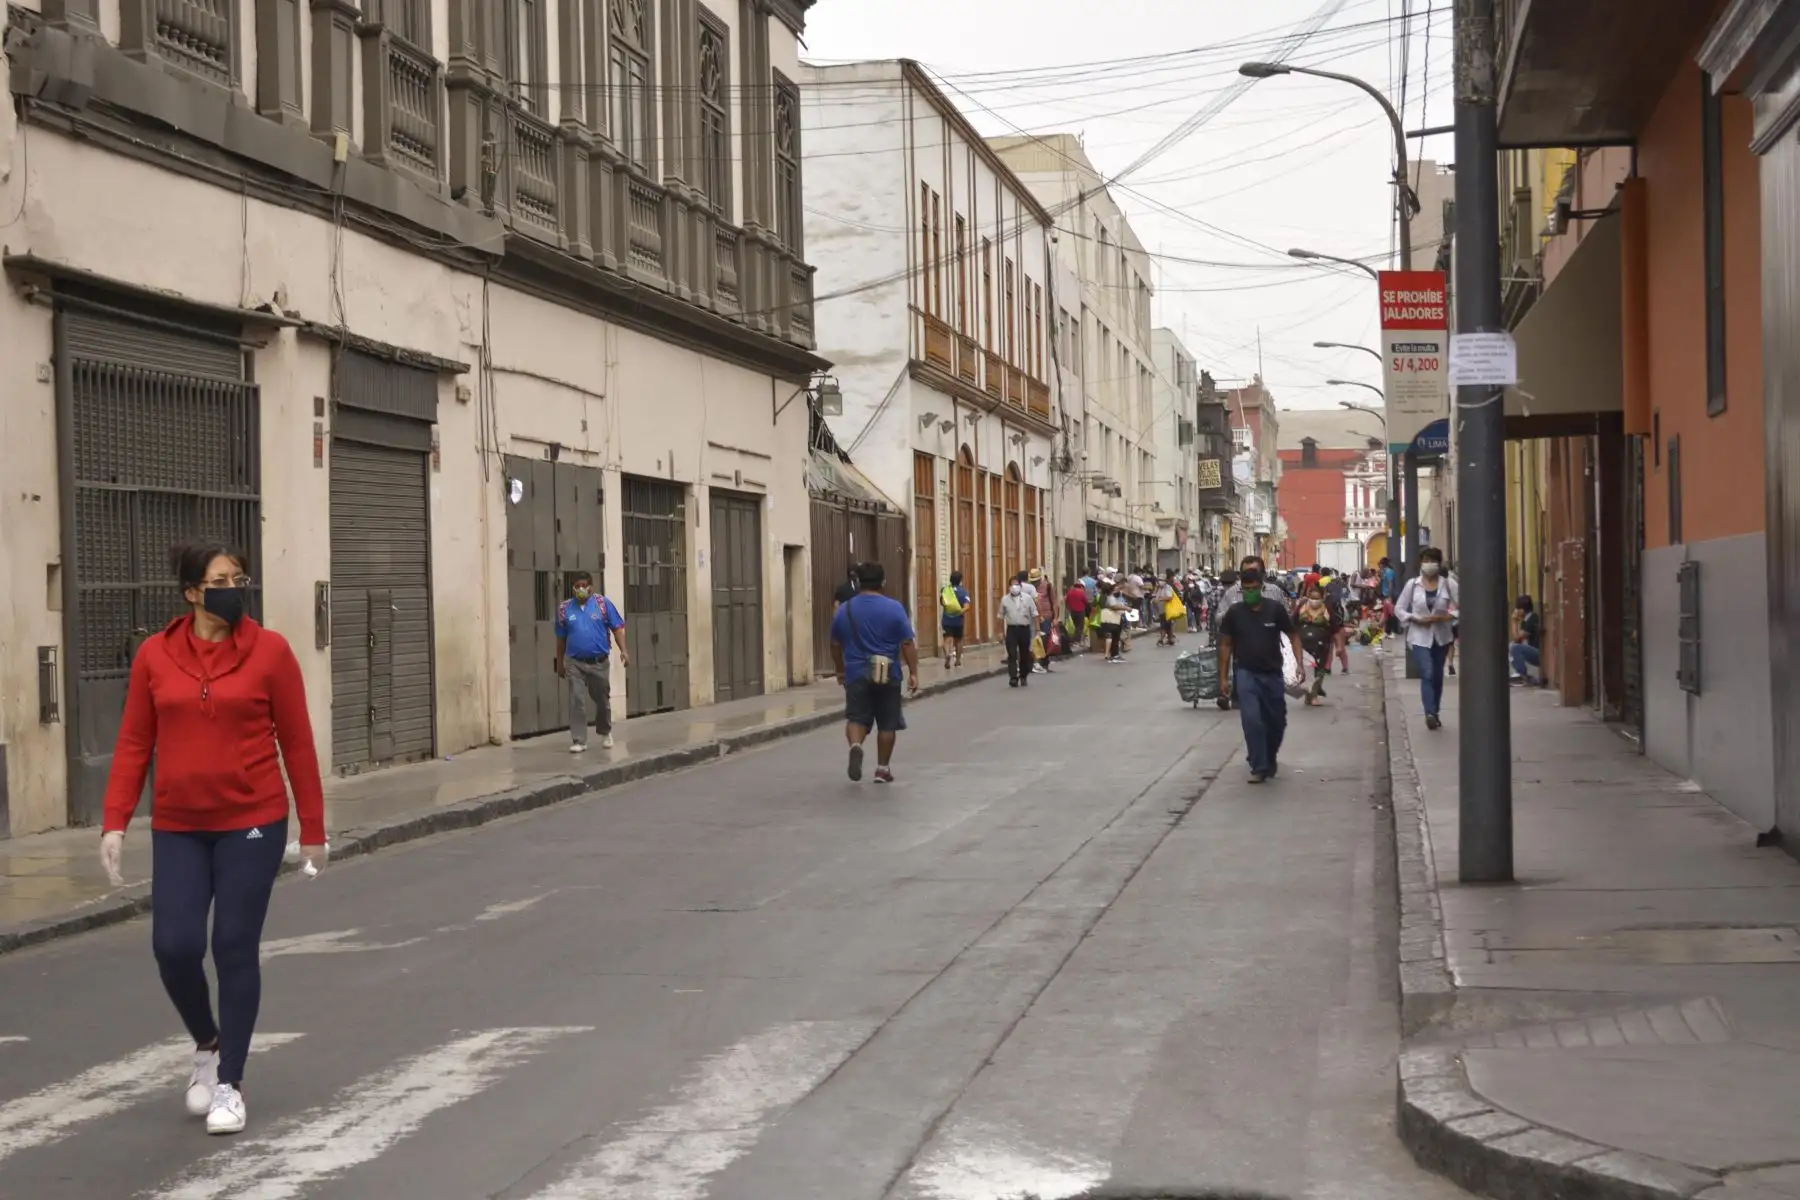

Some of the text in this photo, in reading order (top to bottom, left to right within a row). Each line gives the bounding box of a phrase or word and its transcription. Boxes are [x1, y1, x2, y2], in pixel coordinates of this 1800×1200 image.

[1383, 288, 1443, 304] SE PROHÍBE
[1384, 307, 1444, 322] JALADORES
[1393, 357, 1439, 373] S/ 4,200
[1428, 438, 1448, 449] LIMA
